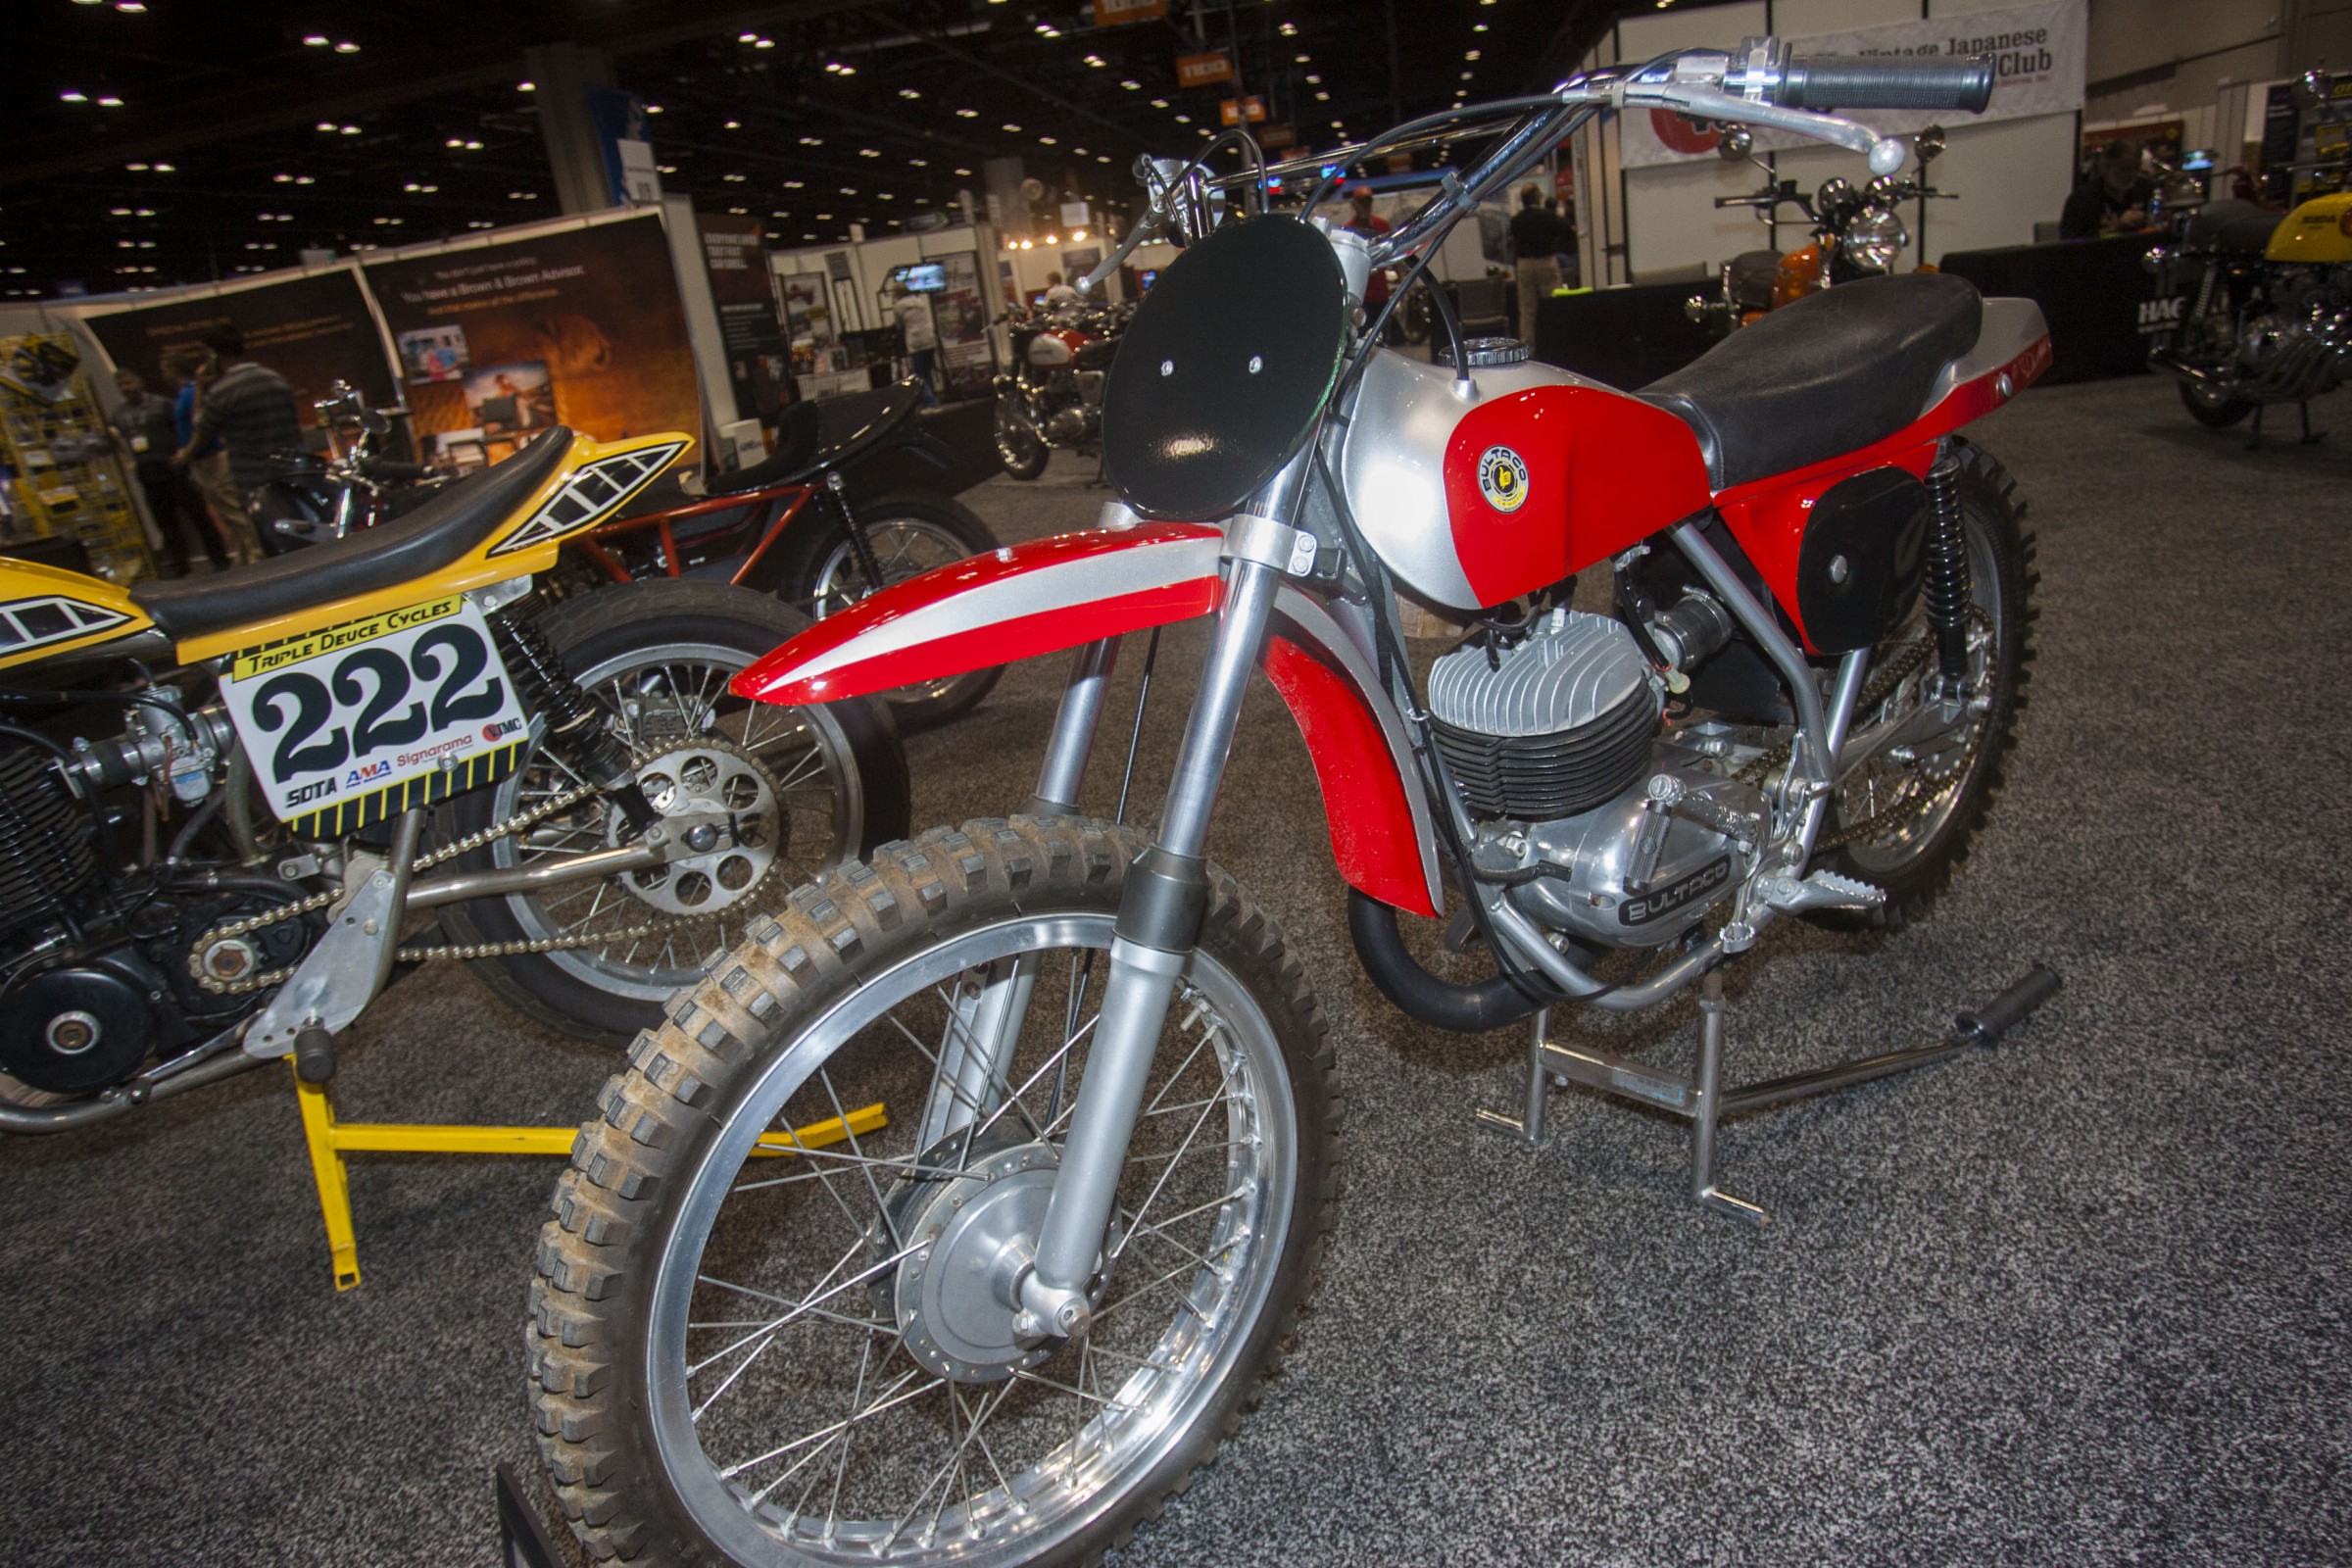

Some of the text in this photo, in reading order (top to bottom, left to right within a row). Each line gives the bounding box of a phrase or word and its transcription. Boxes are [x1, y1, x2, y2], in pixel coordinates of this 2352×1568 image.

[1944, 28, 2047, 56] Japanese
[1997, 49, 2052, 77] Club
[1481, 448, 1527, 492] BULTACO
[251, 623, 505, 784] 222
[396, 734, 472, 767] Signarama
[346, 760, 391, 783] AMA
[1628, 862, 1728, 922] BULTACO
